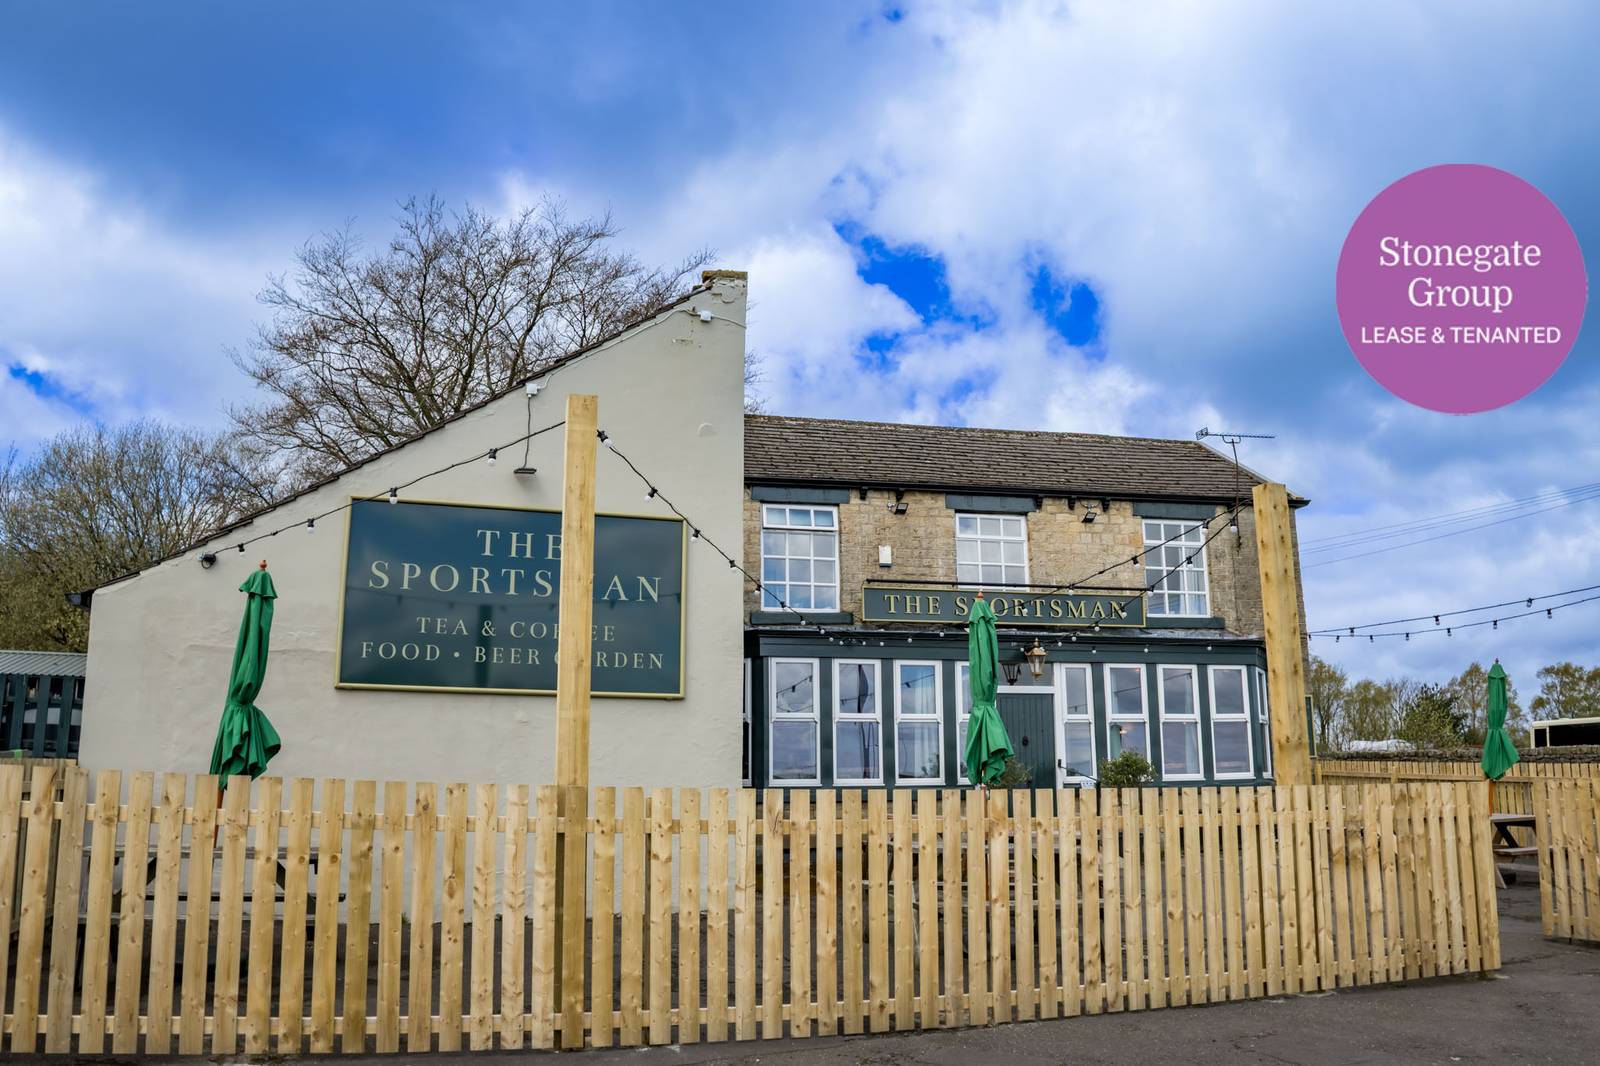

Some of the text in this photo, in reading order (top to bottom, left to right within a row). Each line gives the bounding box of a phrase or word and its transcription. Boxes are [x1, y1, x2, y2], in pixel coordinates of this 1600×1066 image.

[476, 528, 563, 561] THE
[368, 559, 661, 603] SPORTSAN
[884, 594, 1126, 620] THE SORTSMAN
[416, 616, 616, 642] TEA & COEE
[360, 641, 665, 670] FOOD BEER RDEN
